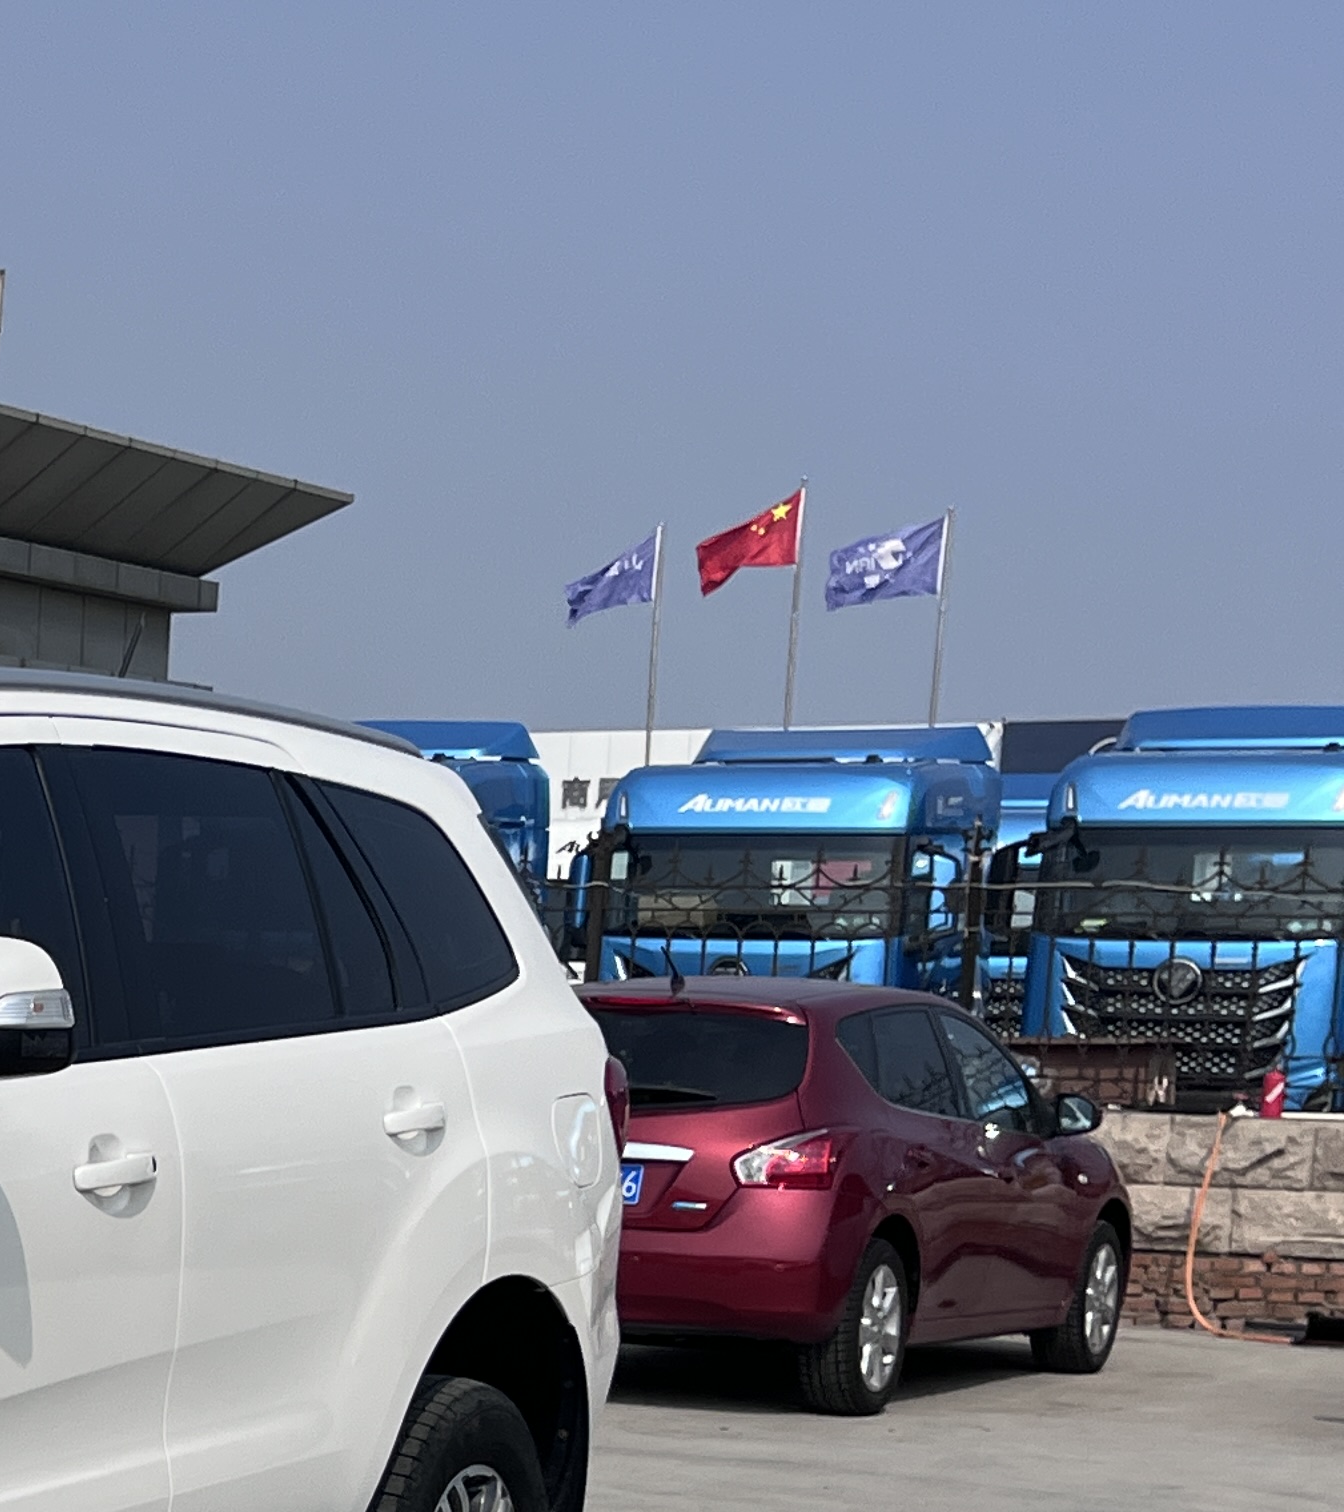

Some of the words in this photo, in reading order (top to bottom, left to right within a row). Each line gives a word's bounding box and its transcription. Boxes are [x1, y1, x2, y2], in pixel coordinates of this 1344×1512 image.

[677, 793, 781, 813] AUMAN
[1117, 788, 1233, 810] AUMAN
[620, 1170, 638, 1198] 6
